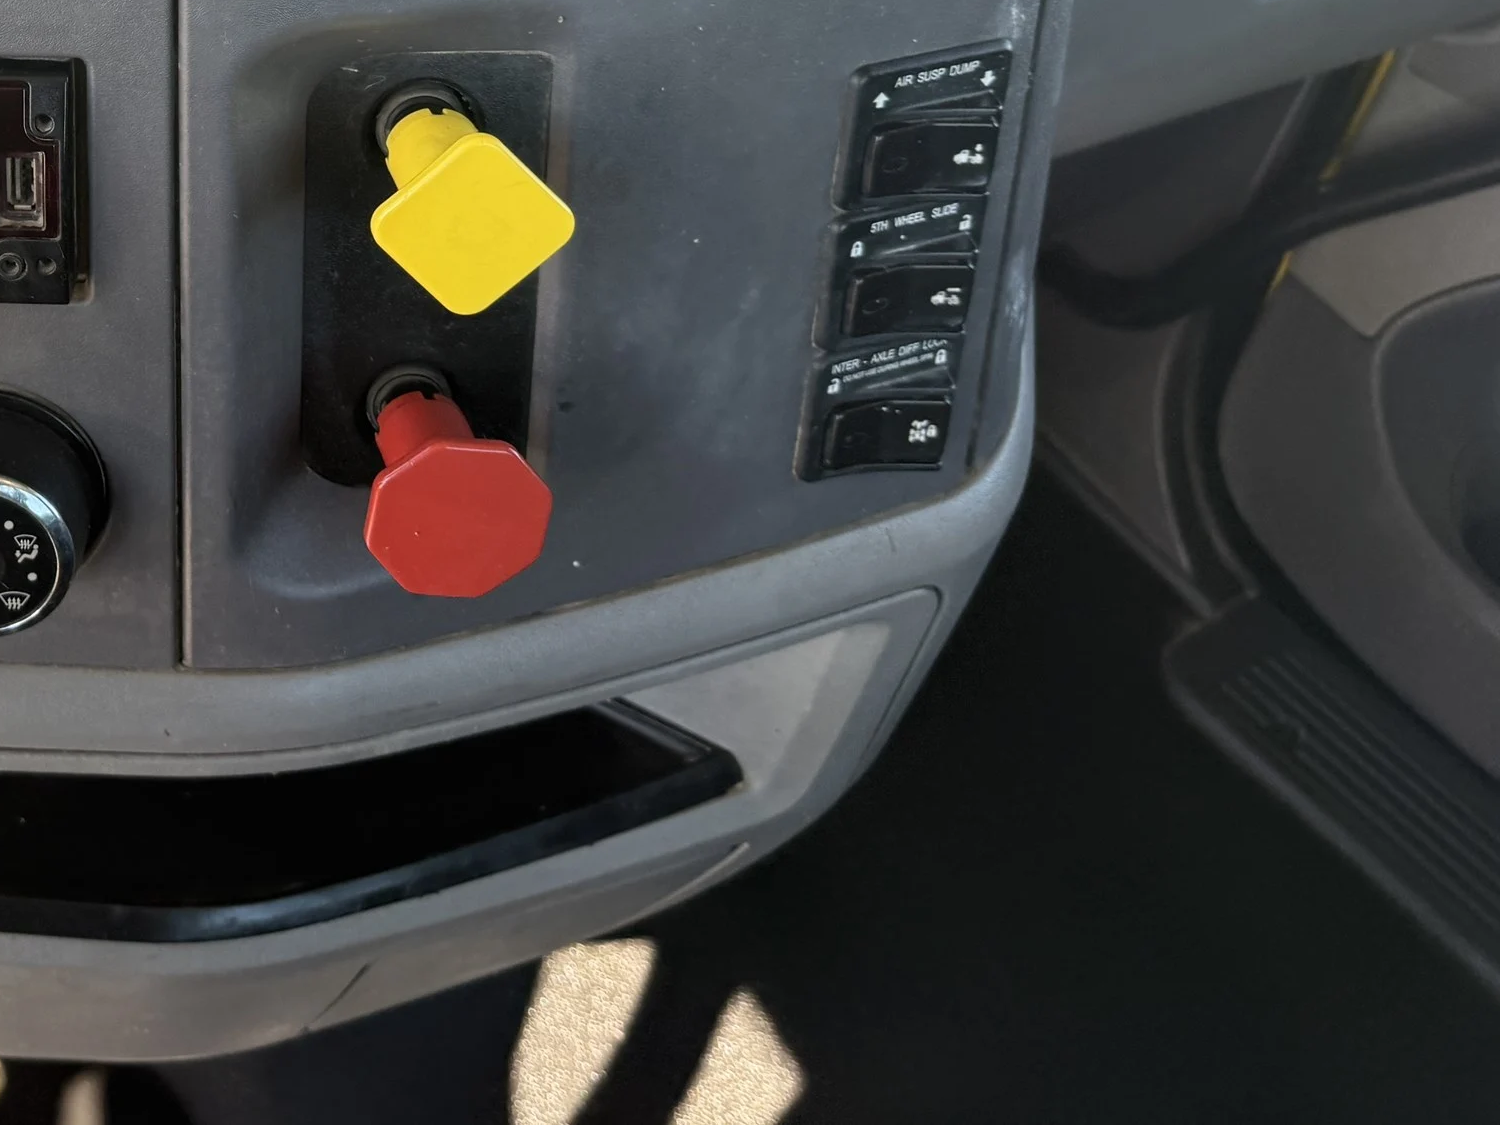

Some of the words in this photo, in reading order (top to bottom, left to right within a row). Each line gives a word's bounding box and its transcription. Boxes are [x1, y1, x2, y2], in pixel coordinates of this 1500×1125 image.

[894, 74, 914, 88] AIR
[916, 67, 947, 83] SUSP
[949, 60, 980, 76] DUMP
[869, 219, 889, 234] 5TH
[893, 211, 926, 228] WHEEL
[931, 202, 960, 219] SLIDE
[831, 358, 861, 375] INTER
[870, 348, 896, 364] AXLE
[898, 341, 920, 356] DIFF
